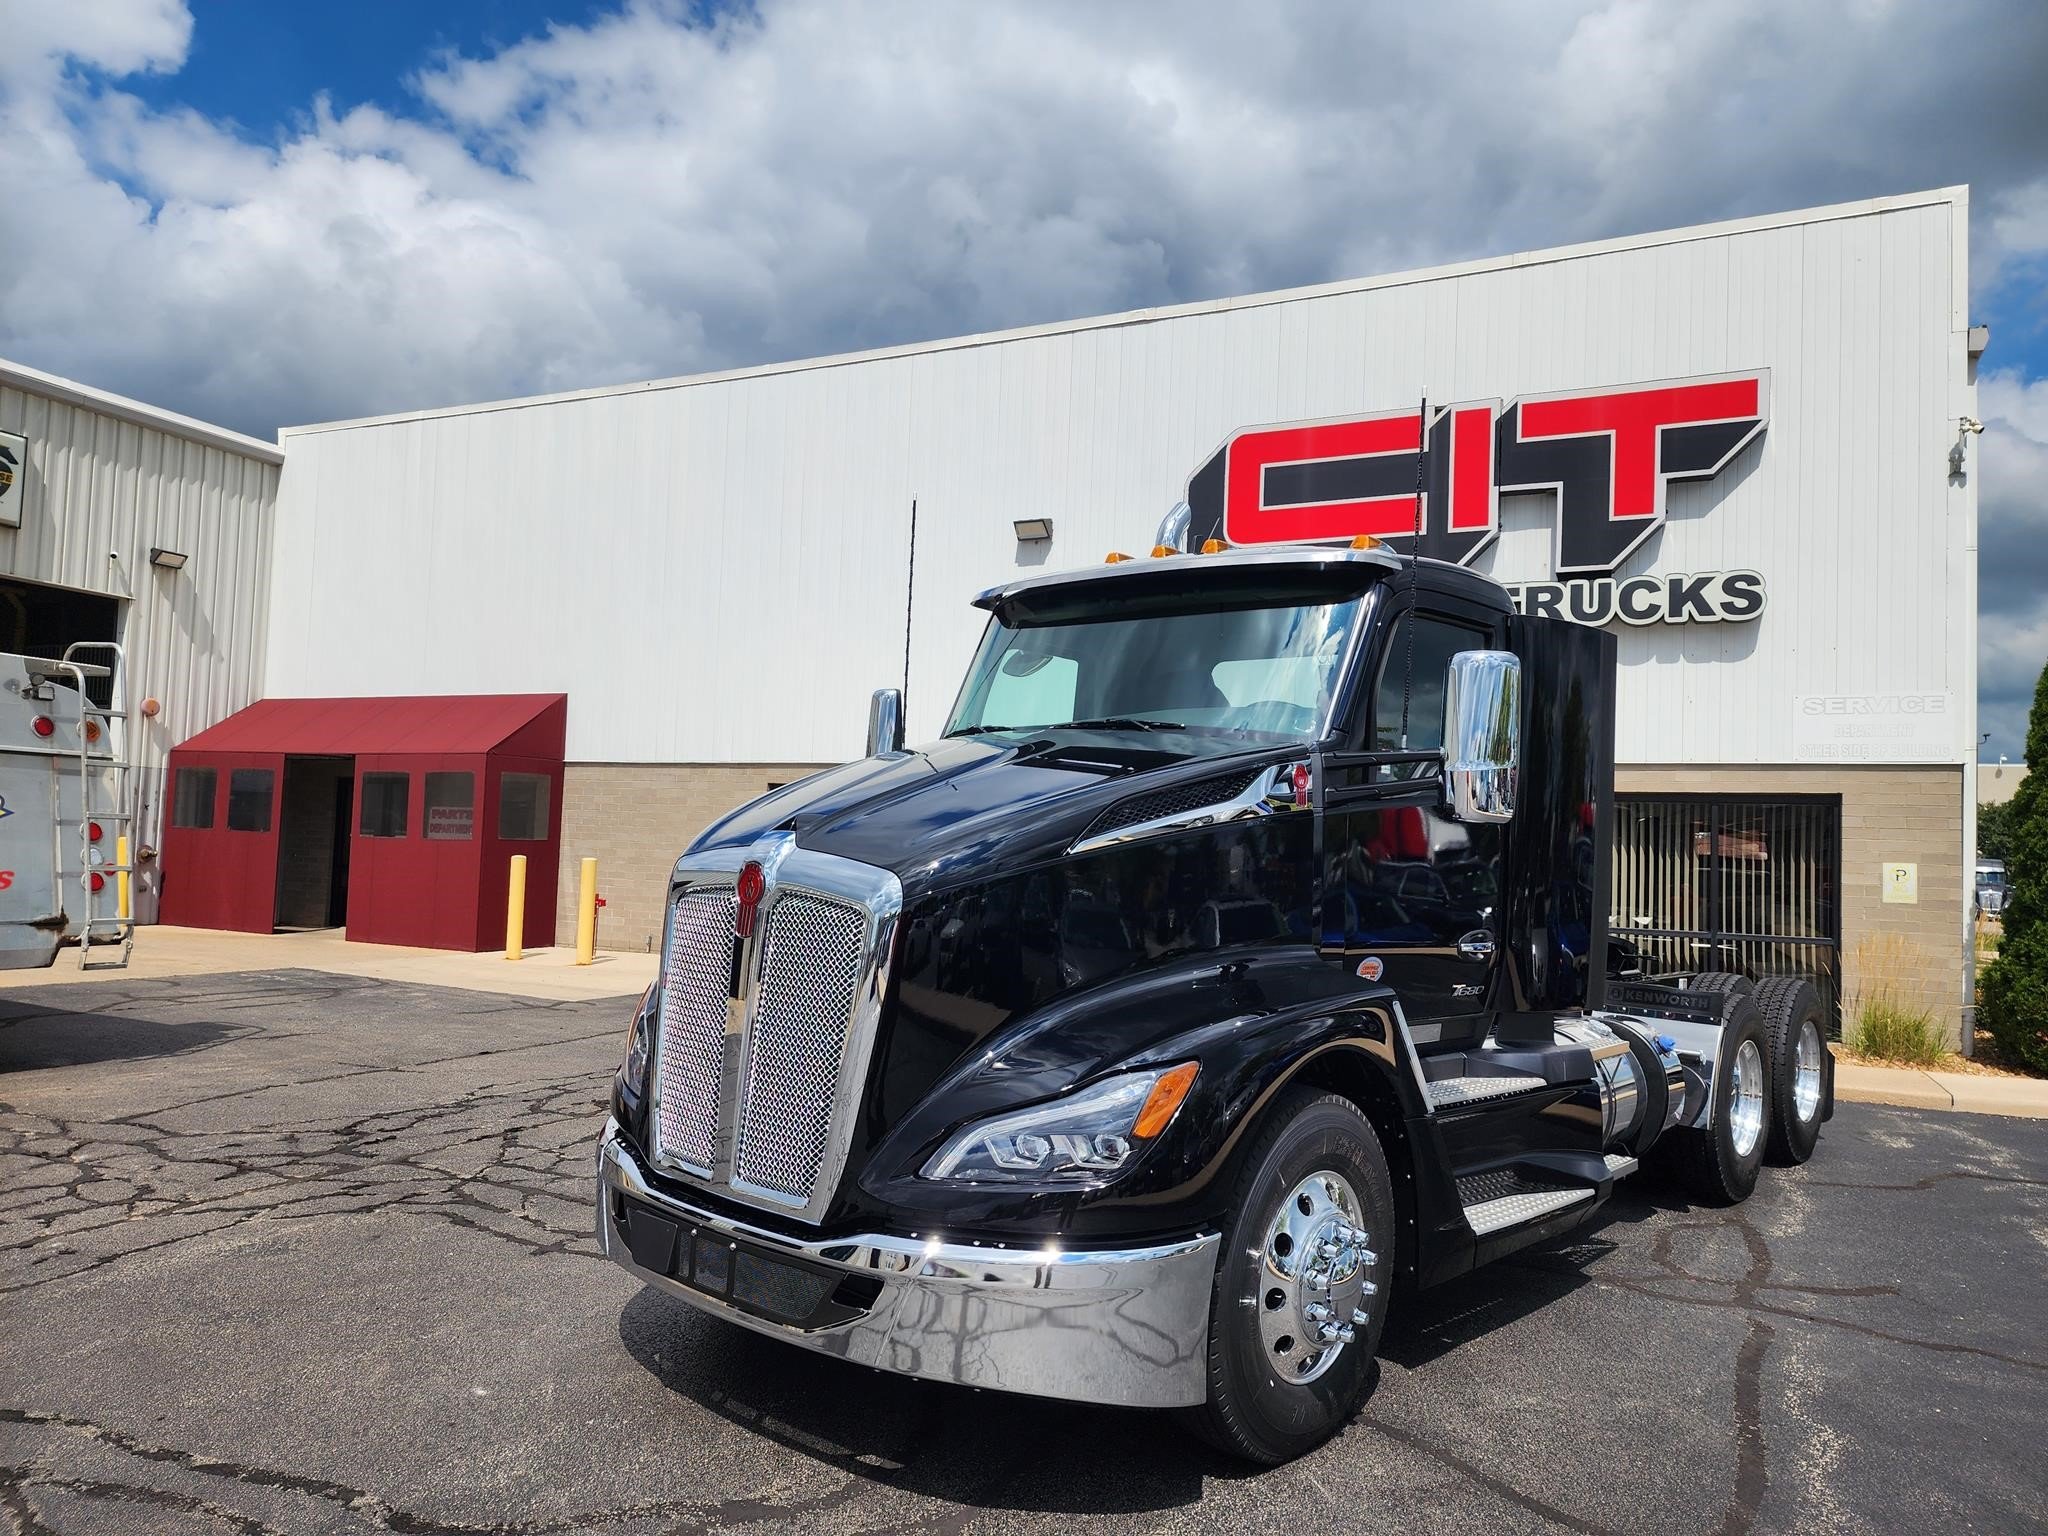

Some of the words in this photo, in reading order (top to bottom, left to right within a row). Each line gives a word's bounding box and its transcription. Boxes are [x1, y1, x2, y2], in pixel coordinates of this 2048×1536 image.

[1205, 368, 1769, 558] CIT
[1802, 695, 1946, 715] SERVICE
[1833, 724, 1914, 738] DEPARTMENT
[1799, 744, 1840, 758] OTHER
[1842, 744, 1870, 758] SIDE
[1892, 744, 1950, 758] BUILDING
[1452, 984, 1485, 997] T680
[1625, 987, 1709, 1009] KENWORTH
